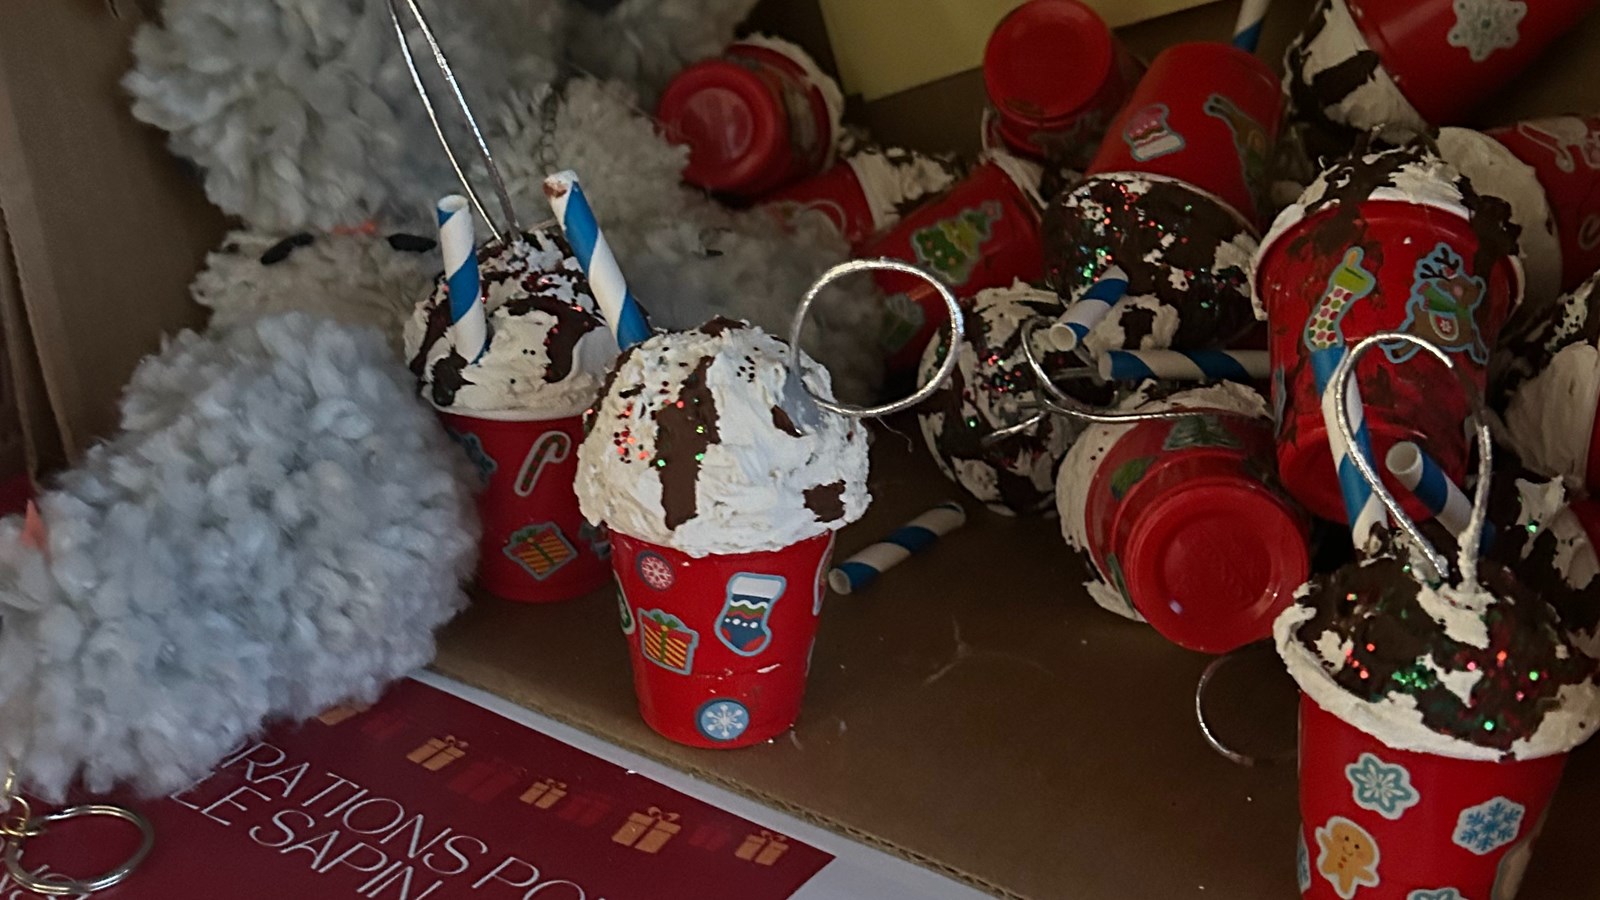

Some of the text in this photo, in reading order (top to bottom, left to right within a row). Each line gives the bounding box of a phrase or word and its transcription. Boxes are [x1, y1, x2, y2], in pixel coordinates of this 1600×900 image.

[221, 741, 606, 900] RATIONS PO
[249, 809, 444, 900] SAPIN
